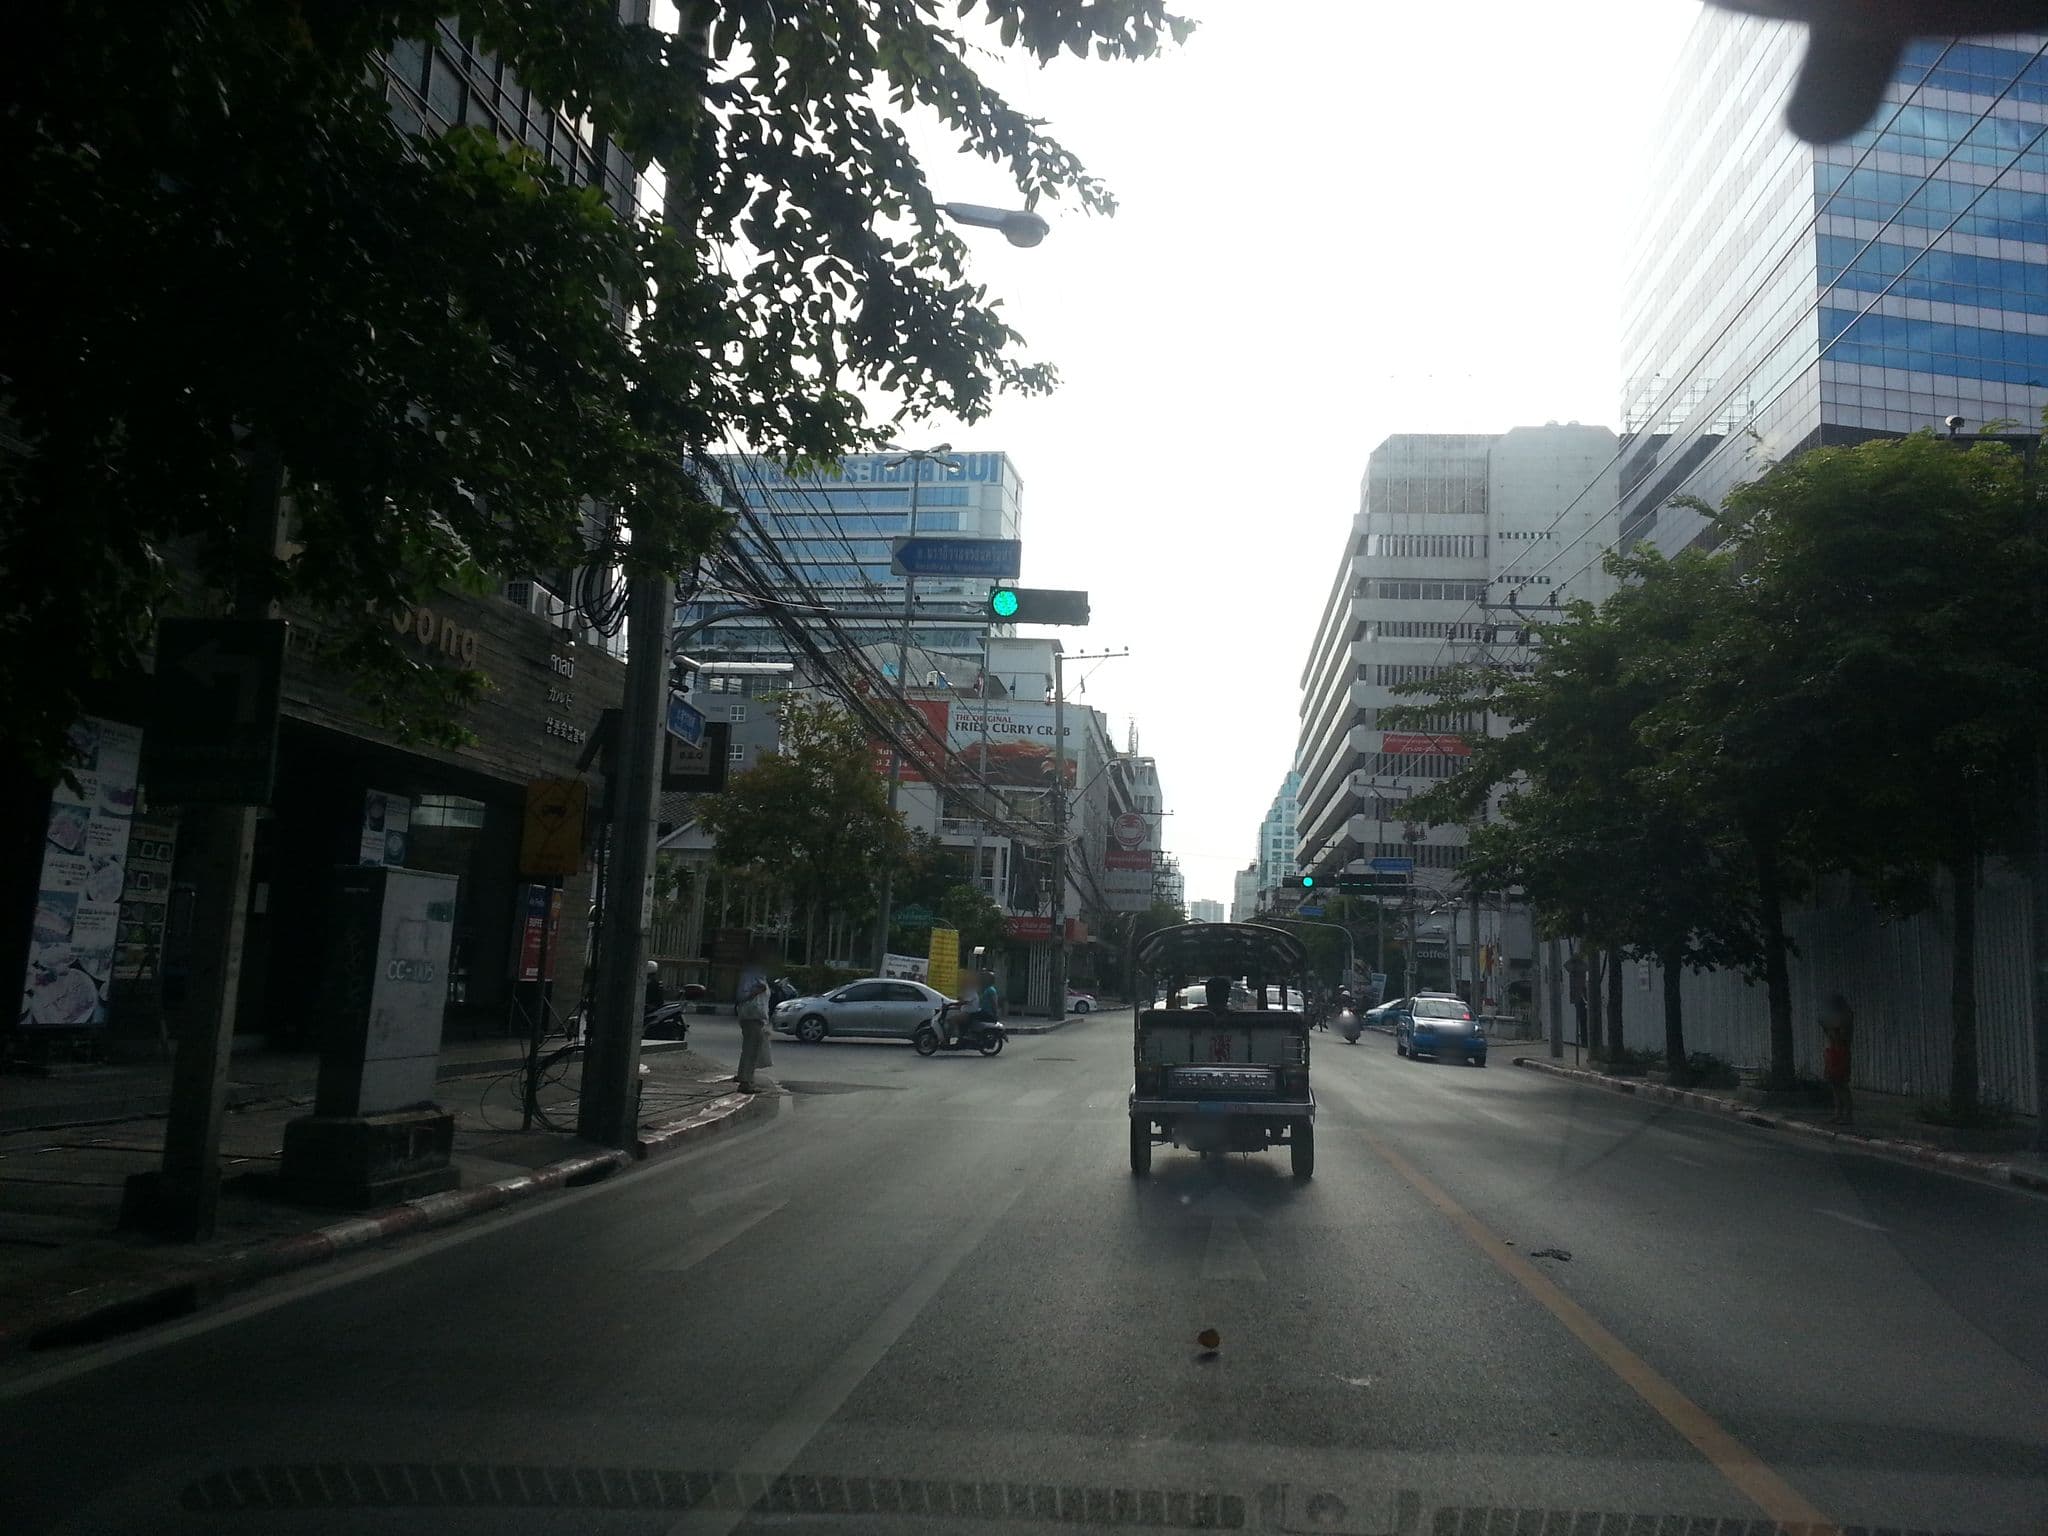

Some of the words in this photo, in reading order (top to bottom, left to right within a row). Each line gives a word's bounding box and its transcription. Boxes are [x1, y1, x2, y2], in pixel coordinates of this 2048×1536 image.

[955, 714, 970, 722] THE
[974, 714, 1013, 724] ORGINAL
[992, 723, 1034, 735] CURRY
